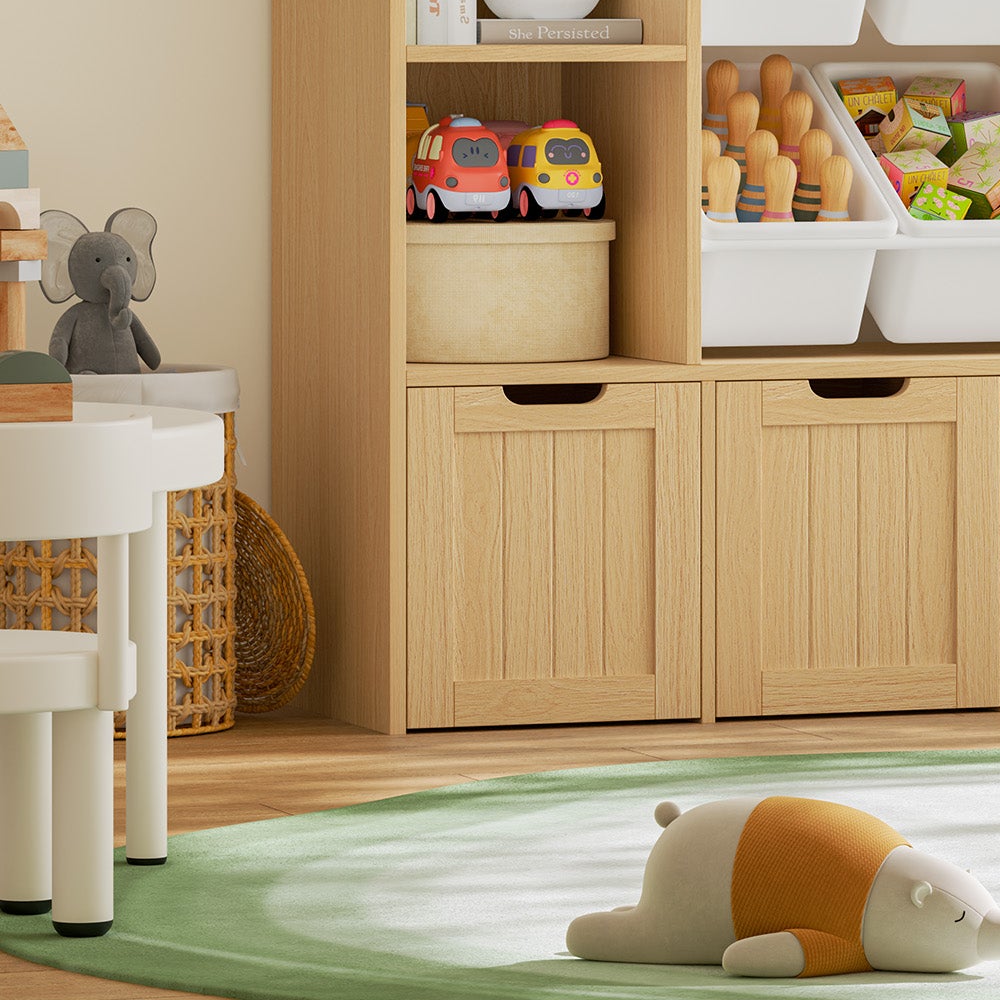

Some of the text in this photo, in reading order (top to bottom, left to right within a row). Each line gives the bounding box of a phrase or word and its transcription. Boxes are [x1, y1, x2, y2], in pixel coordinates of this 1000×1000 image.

[509, 25, 610, 40] She Persisted
[848, 97, 860, 107] UN
